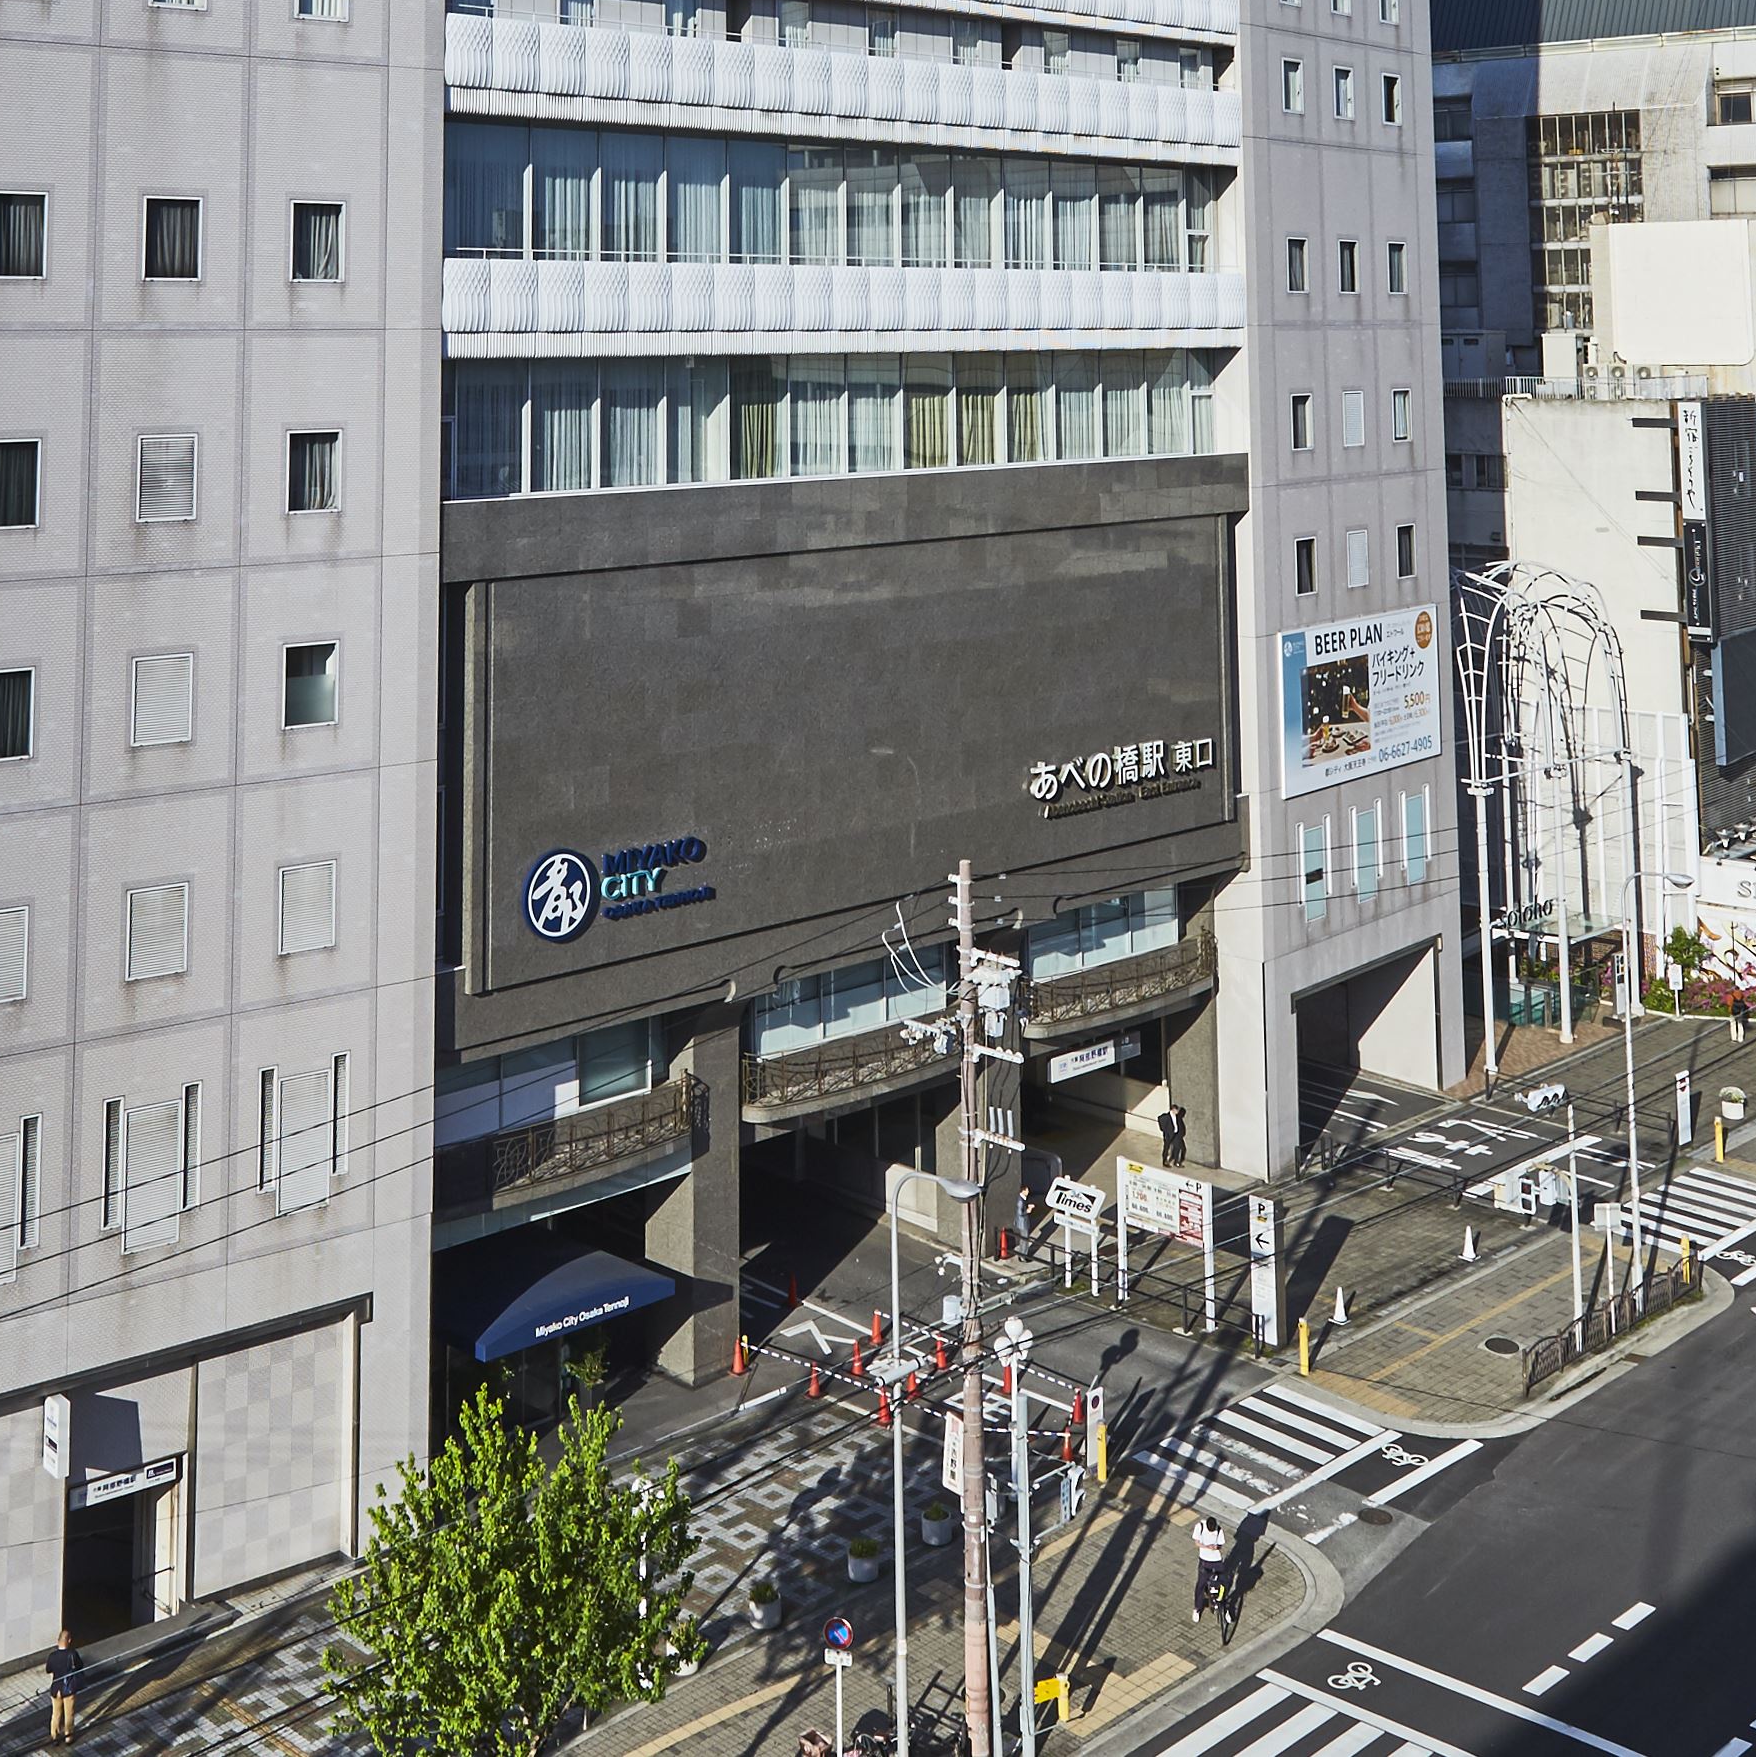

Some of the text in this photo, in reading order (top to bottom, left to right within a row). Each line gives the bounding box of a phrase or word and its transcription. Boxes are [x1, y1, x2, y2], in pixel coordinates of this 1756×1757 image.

[1314, 622, 1383, 656] BEER PLAN
[1372, 660, 1425, 687] フリードリンク
[1378, 734, 1433, 763] 06-6627-4905
[1029, 737, 1214, 800] あべの橋駅 東口
[601, 836, 708, 876] MIYAKO
[600, 867, 663, 901] CITY
[601, 883, 717, 921] OSAKA TENNOJI
[1055, 1189, 1093, 1214] Times
[1257, 1202, 1266, 1215] P
[535, 1295, 630, 1338] Miyako City Osaka Tennoji
